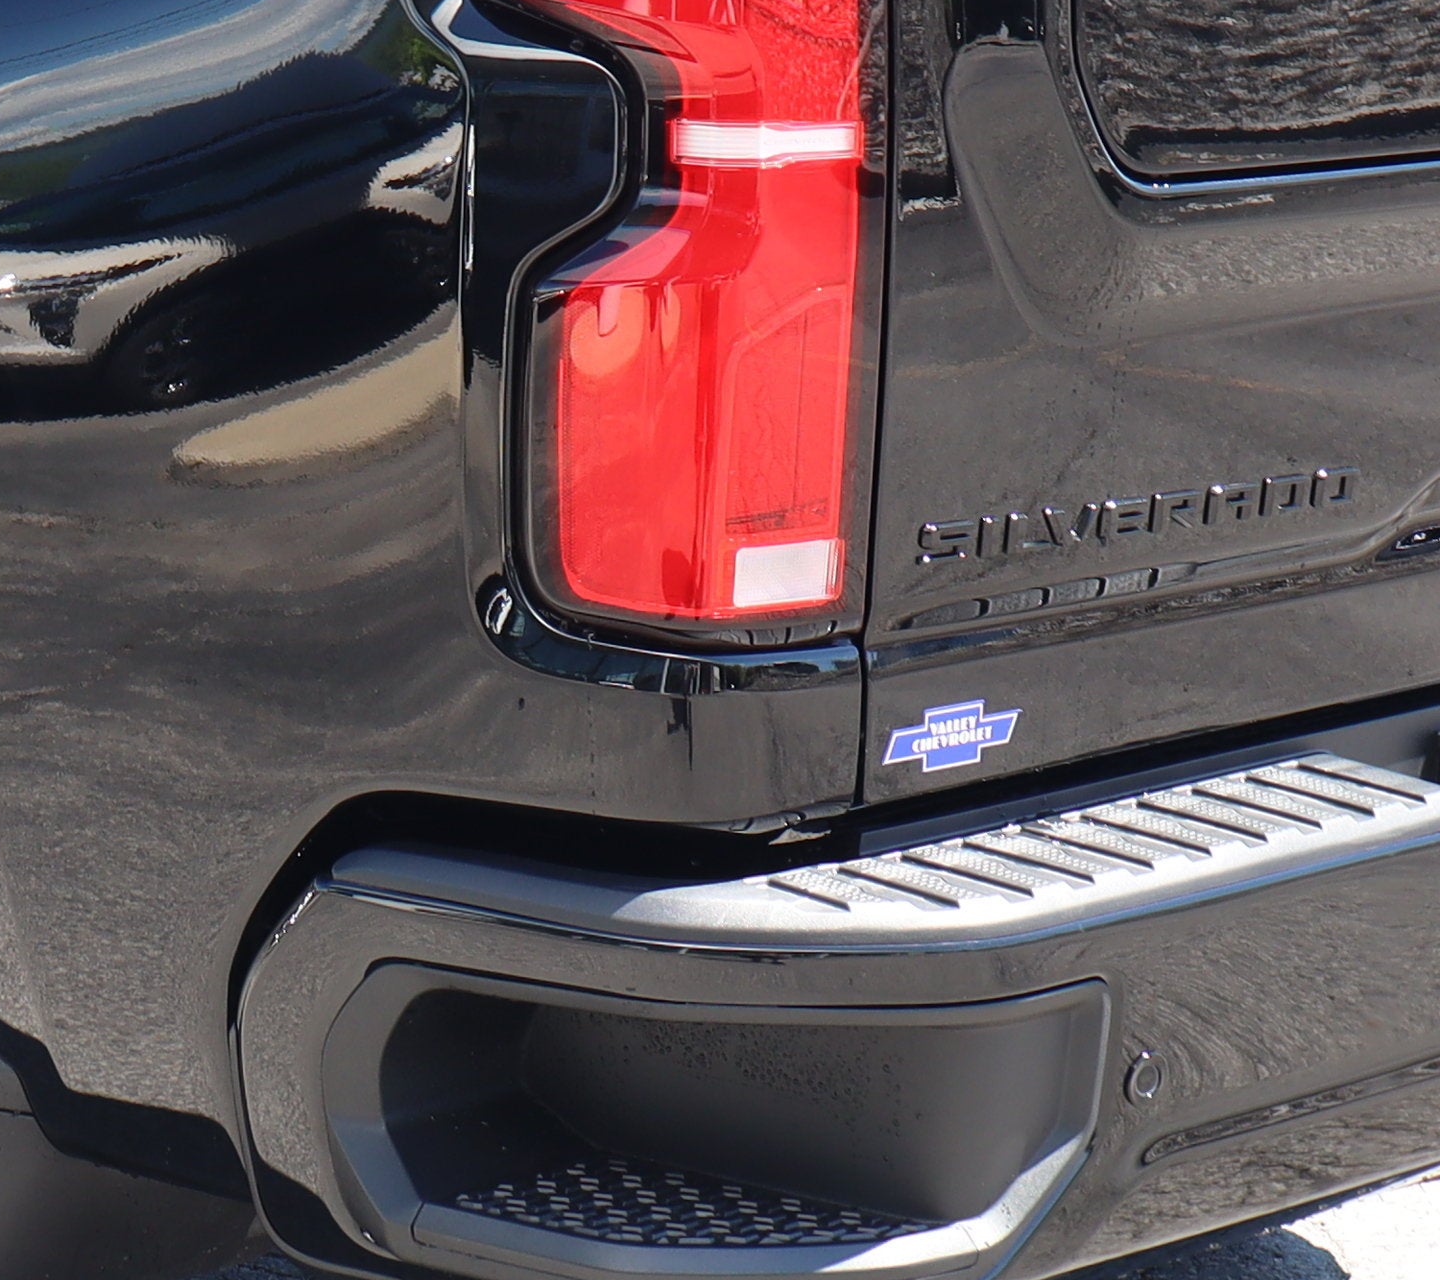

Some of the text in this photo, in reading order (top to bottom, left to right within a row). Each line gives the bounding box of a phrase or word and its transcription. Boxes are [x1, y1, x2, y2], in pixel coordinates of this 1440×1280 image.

[916, 465, 1361, 565] SILVERADO
[911, 726, 993, 753] CHEVROLET
[929, 716, 978, 736] VALLEY
